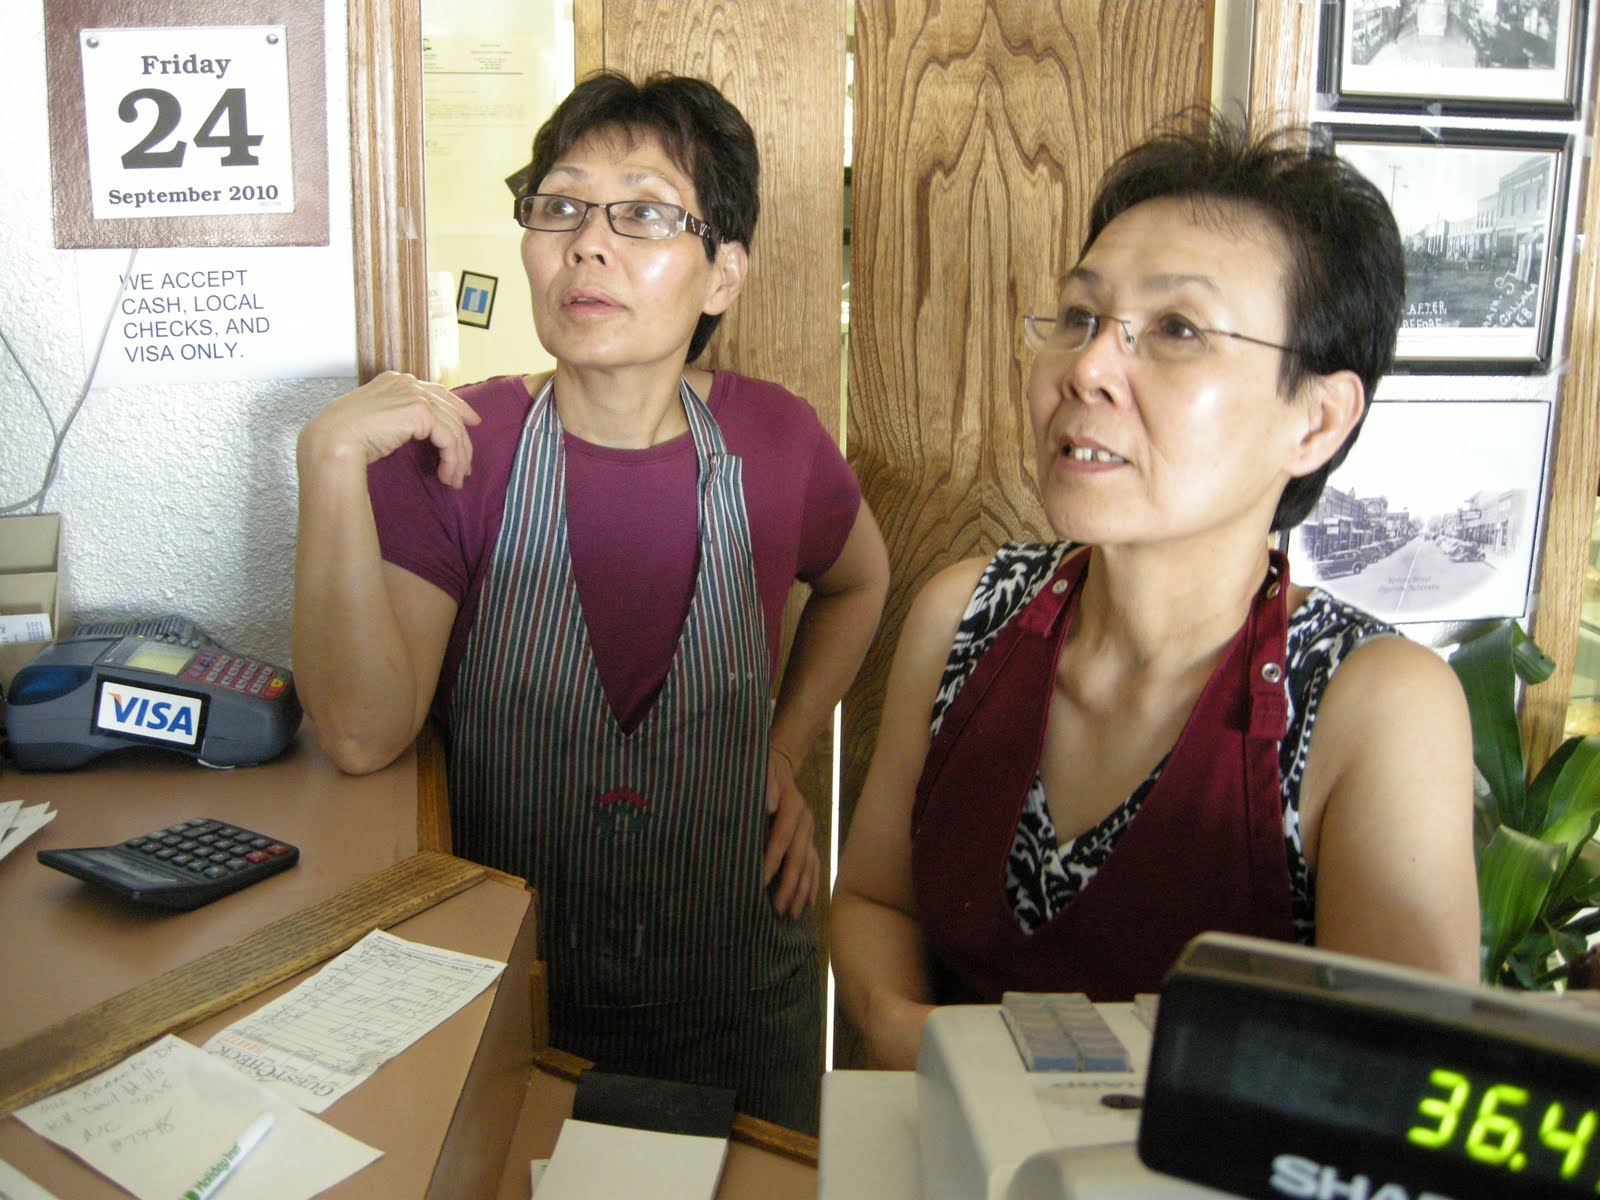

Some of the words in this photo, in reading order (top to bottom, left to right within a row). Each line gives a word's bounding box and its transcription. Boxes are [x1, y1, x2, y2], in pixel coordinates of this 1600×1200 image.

[141, 54, 231, 79] Friday
[118, 88, 264, 169] 24
[109, 187, 221, 208] September
[229, 184, 279, 201] 2010
[119, 273, 154, 290] WE
[161, 270, 248, 289] ACCEPT
[121, 296, 188, 315] CASH,
[194, 293, 264, 312] LOCAL
[123, 319, 219, 339] CHECKS,
[226, 317, 270, 334] AND
[125, 345, 174, 363] VISA
[180, 342, 244, 360] ONLY.
[107, 691, 194, 736] VISA
[1406, 1068, 1600, 1196] 36.4
